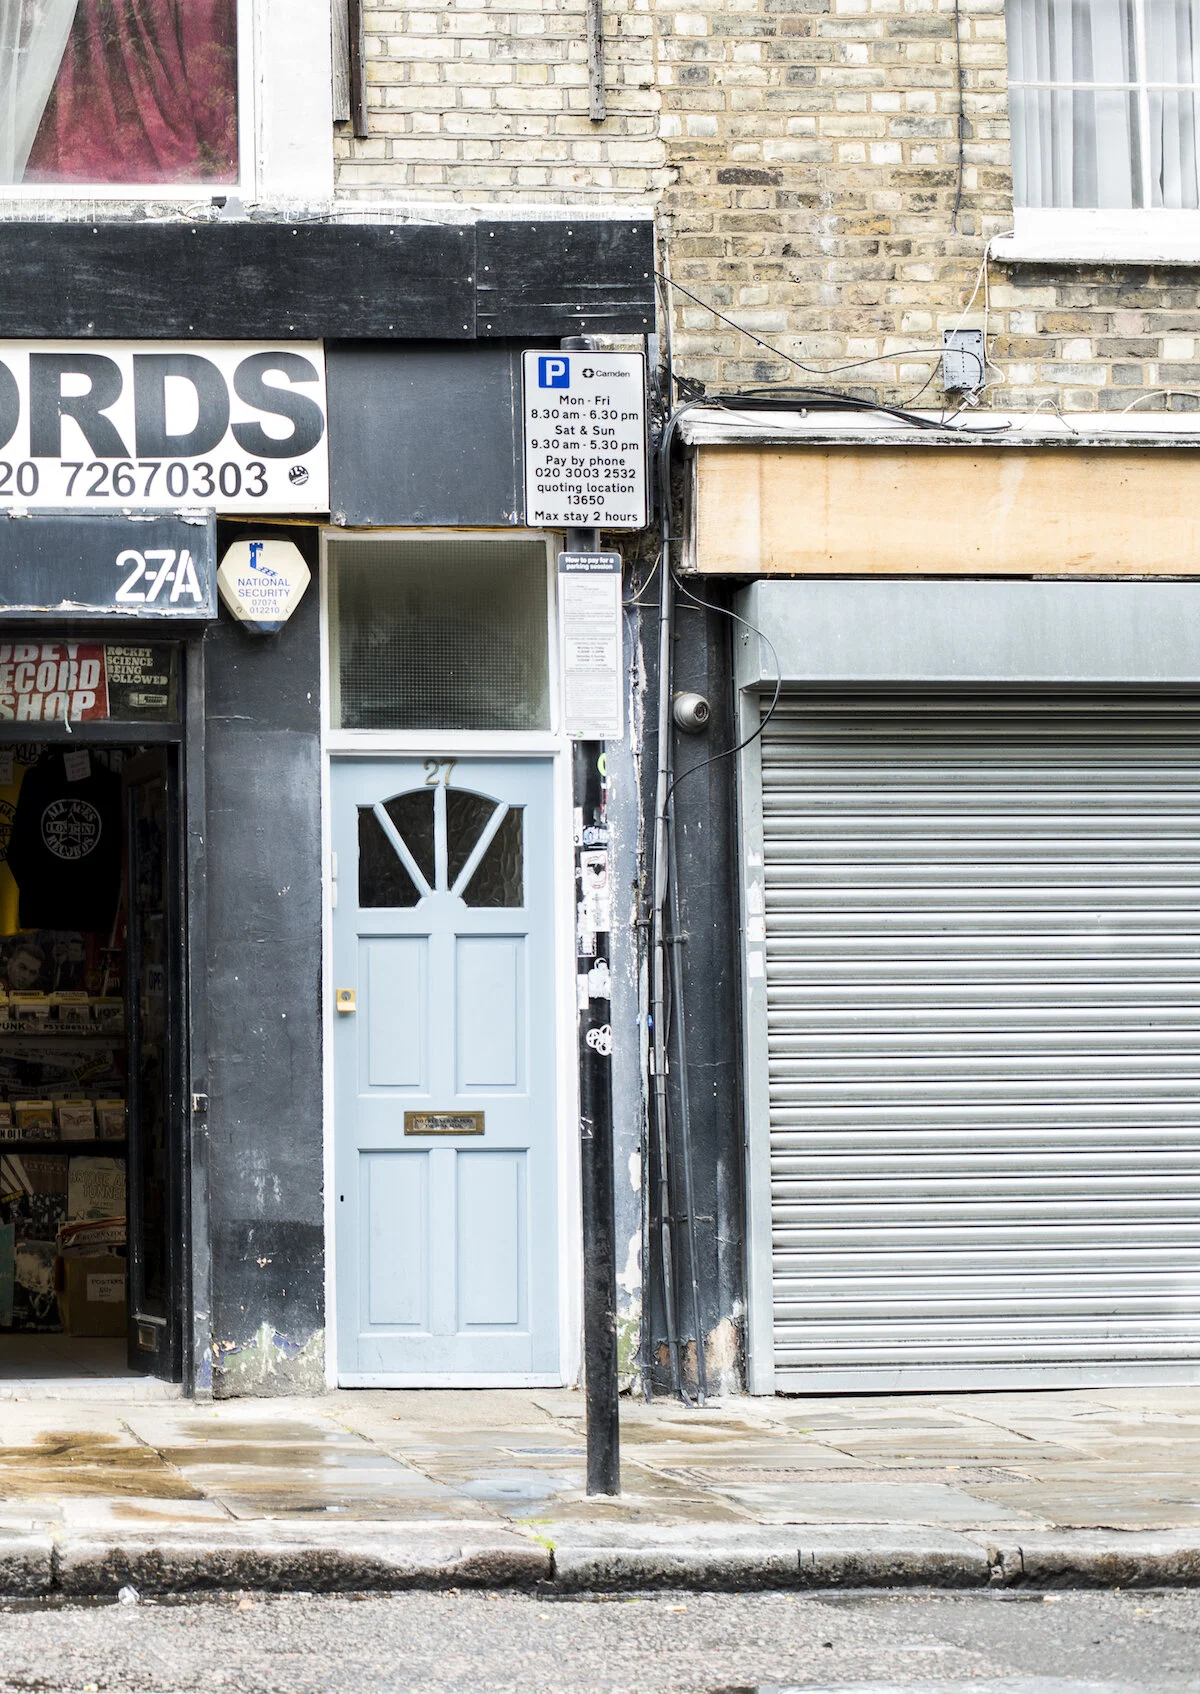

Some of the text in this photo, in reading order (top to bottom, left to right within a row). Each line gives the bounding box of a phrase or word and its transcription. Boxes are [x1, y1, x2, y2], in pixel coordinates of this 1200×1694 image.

[545, 360, 566, 387] P
[596, 370, 631, 378] Camden
[559, 395, 585, 406] Mon
[594, 395, 610, 406] Fri
[531, 409, 560, 420] 8.30
[562, 411, 580, 420] am
[589, 409, 618, 420] 6.30
[621, 411, 639, 422] pm
[555, 425, 615, 436] Sat & Sun
[531, 439, 560, 450] 9.30
[562, 441, 580, 450] am
[590, 440, 618, 450] 5.30
[621, 442, 639, 452] pm
[546, 455, 626, 467] Pay by phone
[535, 467, 636, 479] 020 3003 2532
[61, 460, 269, 499] 72670303
[537, 483, 635, 494] quoting location
[567, 495, 606, 505] 13650
[534, 511, 638, 523] Max stay 2 hours
[566, 563, 589, 571] parking
[115, 549, 202, 603] 27A
[238, 578, 291, 587] NATIONAL
[238, 589, 291, 598] SECURITY
[252, 598, 277, 606] 07074
[249, 606, 280, 615] 012210
[107, 647, 152, 657] ROCKET
[107, 657, 153, 667] SCIENCE
[107, 666, 141, 675] BEING
[423, 758, 458, 785] 27
